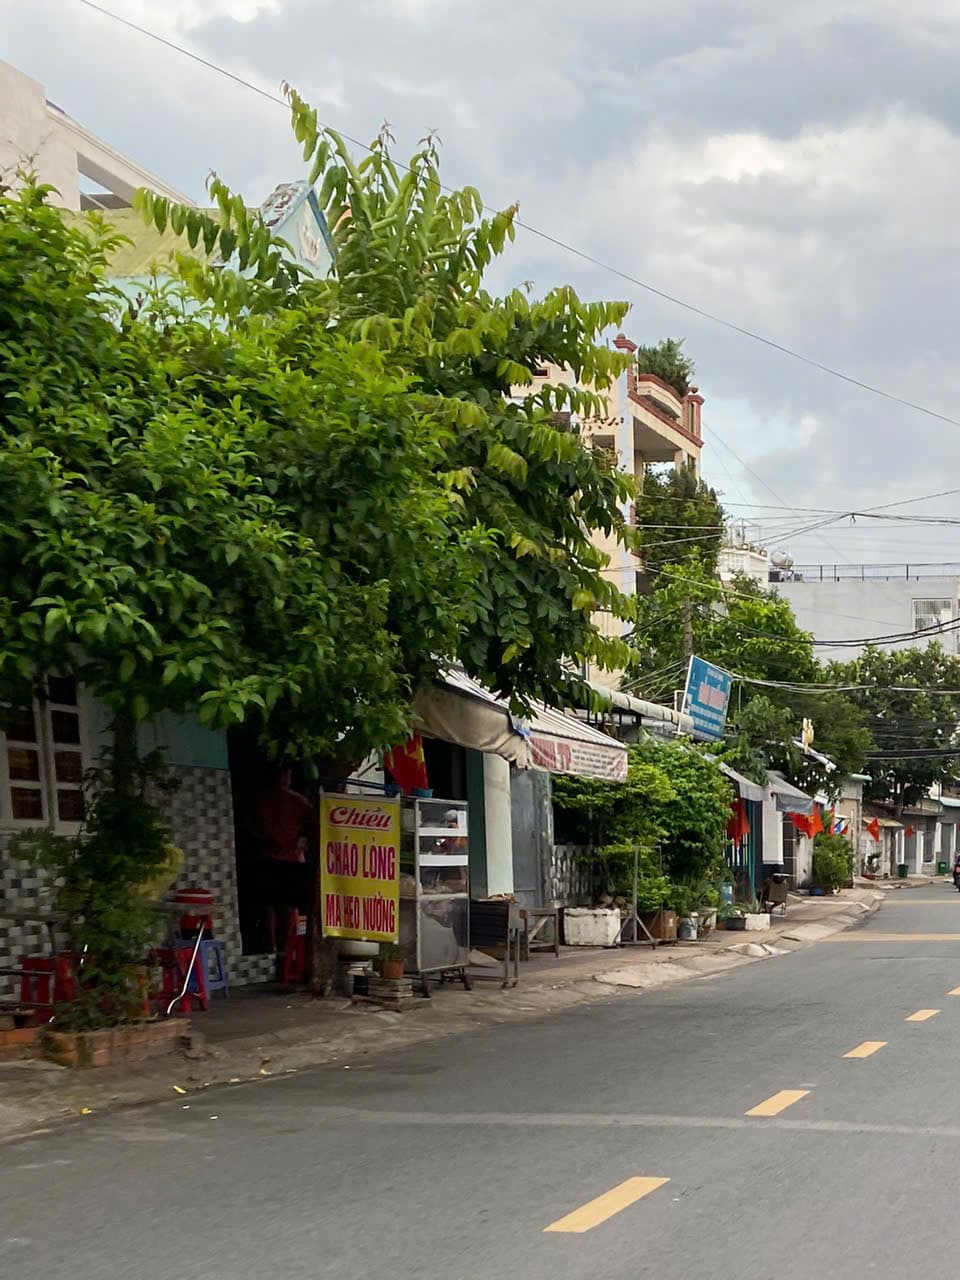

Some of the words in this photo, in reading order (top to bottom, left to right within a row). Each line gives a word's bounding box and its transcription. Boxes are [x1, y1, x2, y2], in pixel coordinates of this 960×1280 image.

[329, 806, 392, 828] Chiều
[326, 835, 359, 877] CHÁO
[362, 836, 395, 880] LÒNG
[344, 895, 360, 930] HEO
